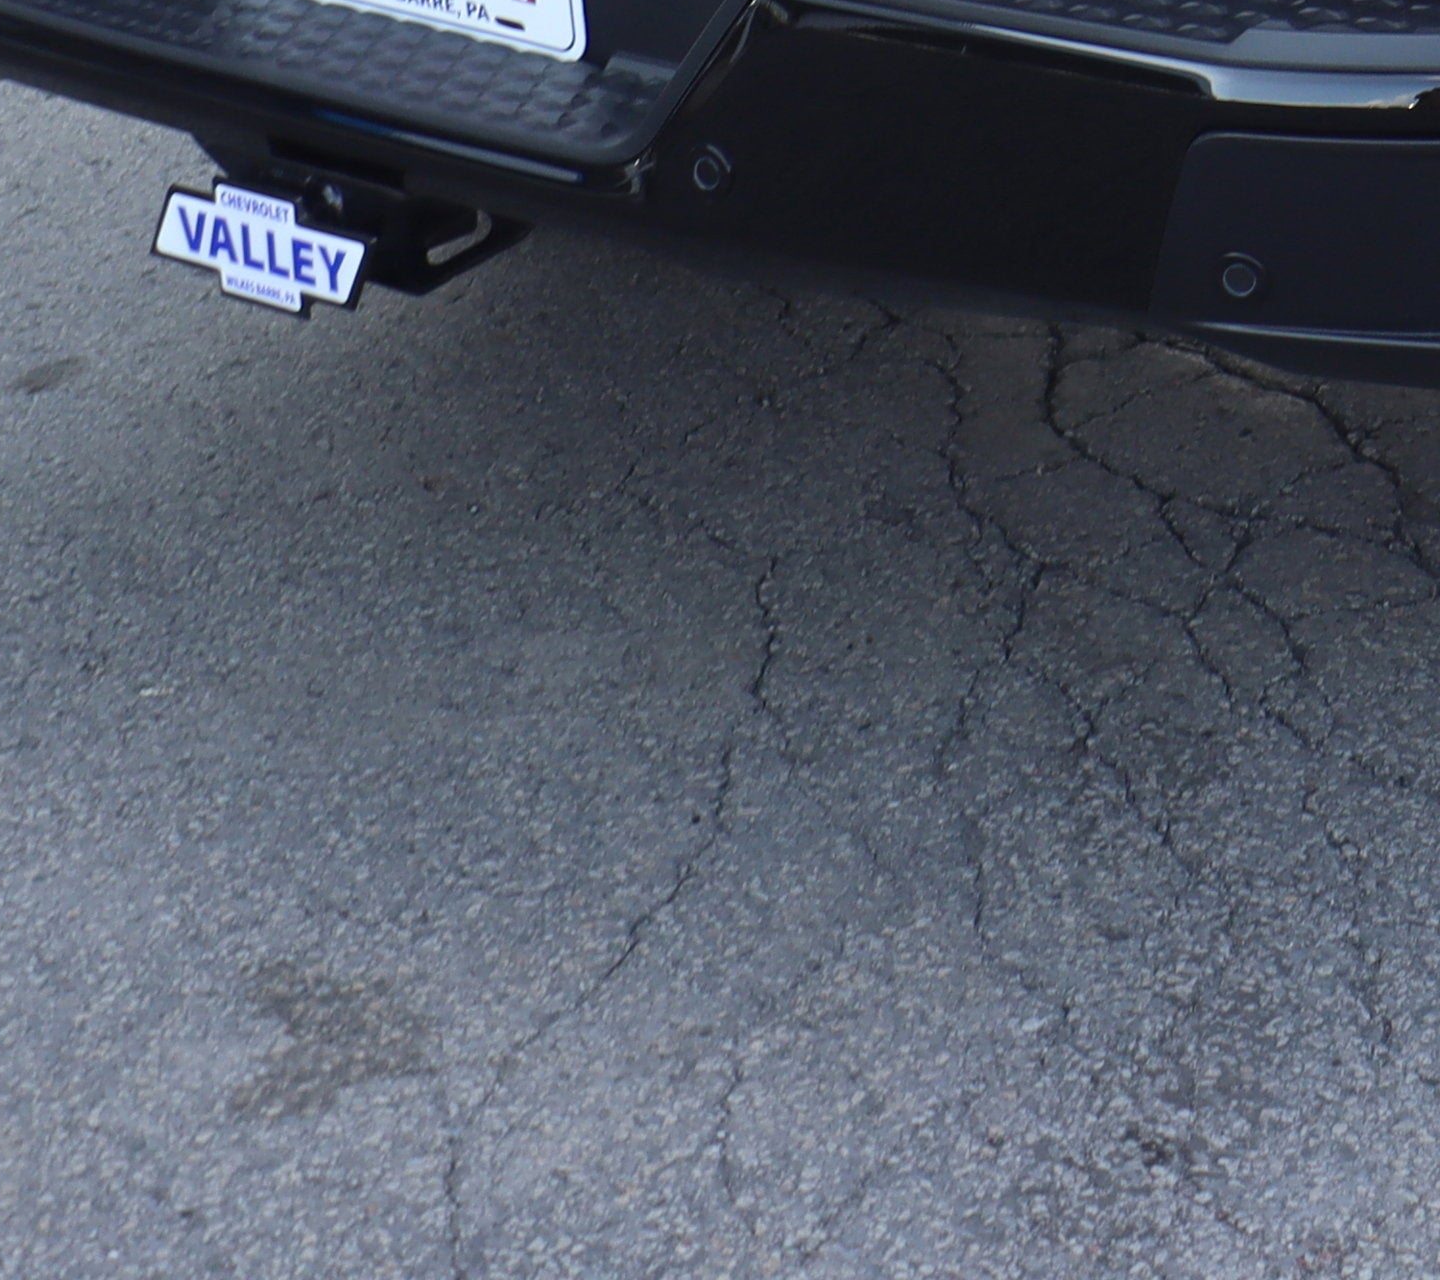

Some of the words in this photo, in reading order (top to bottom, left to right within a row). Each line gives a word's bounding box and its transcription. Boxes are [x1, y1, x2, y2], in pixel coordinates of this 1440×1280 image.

[465, 0, 490, 23] PA
[219, 190, 291, 224] CHEVROLET
[177, 205, 347, 294] VALLEY
